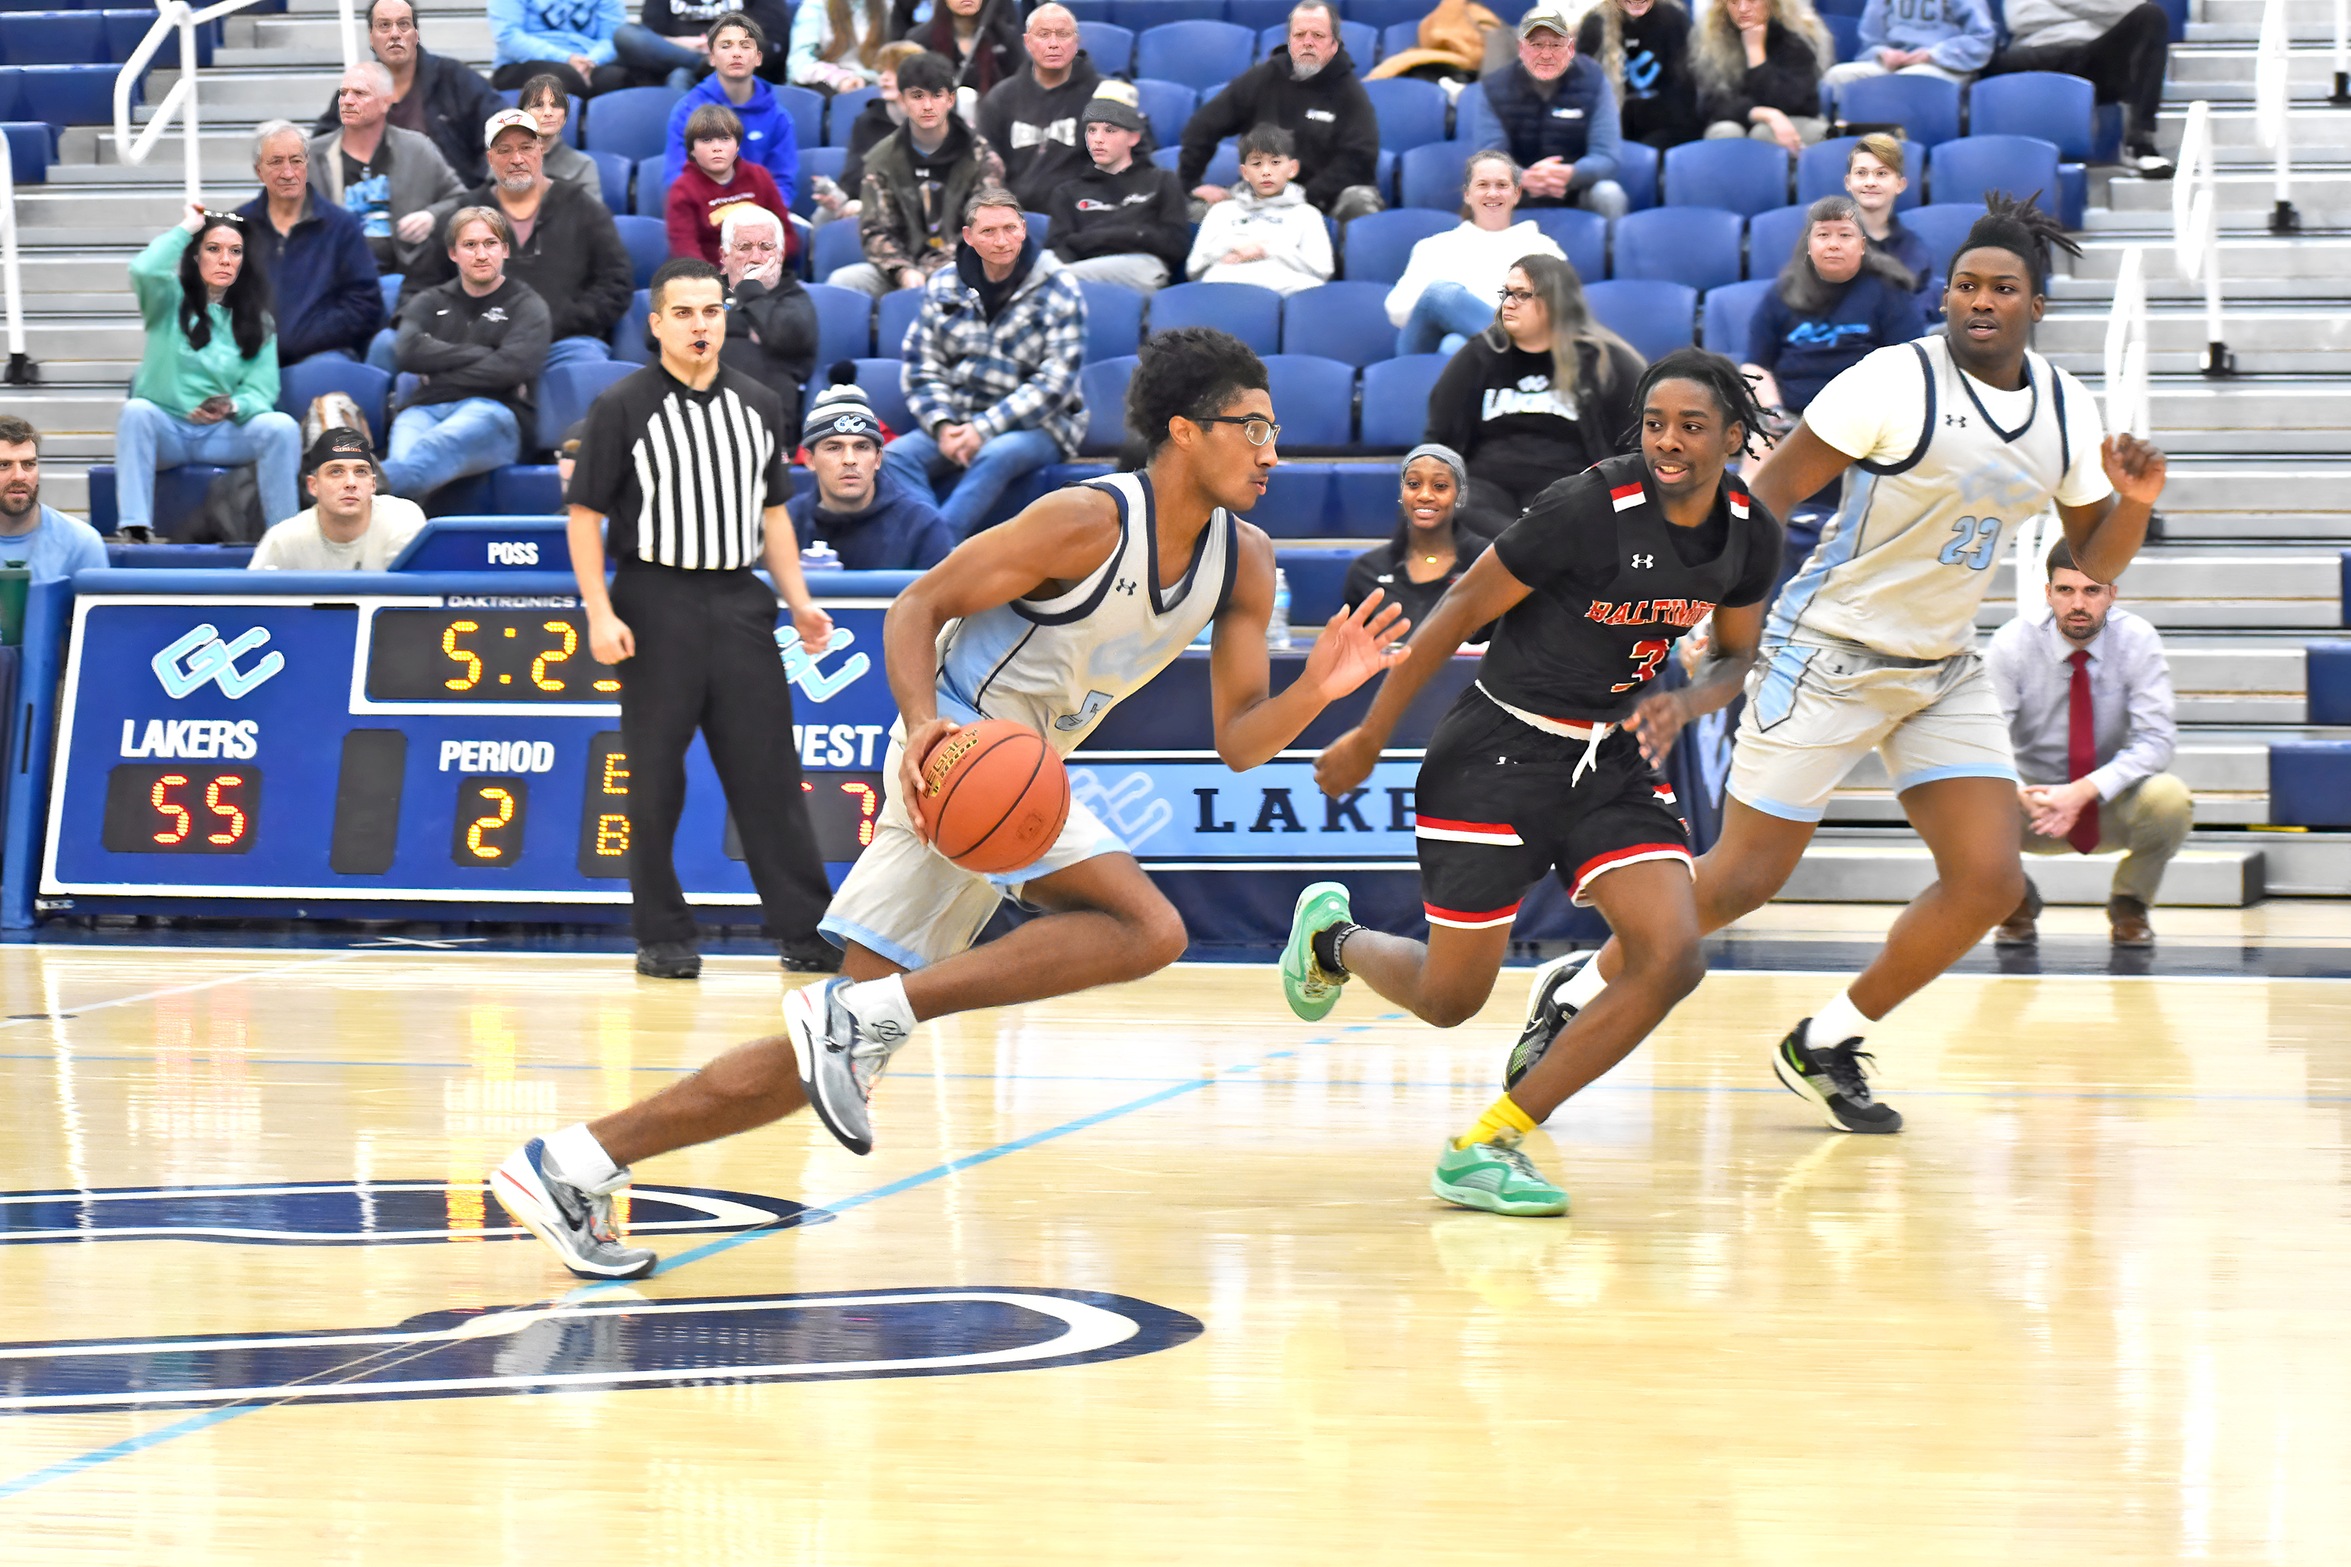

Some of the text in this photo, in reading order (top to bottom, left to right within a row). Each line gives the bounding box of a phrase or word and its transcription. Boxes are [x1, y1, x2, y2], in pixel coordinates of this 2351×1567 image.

[487, 542, 540, 565] POSS
[1938, 515, 2003, 571] 23
[447, 595, 577, 608] DAKTRONICS
[151, 623, 286, 700] GC
[442, 619, 622, 692] 5:2
[1610, 638, 1670, 693] 3
[120, 719, 259, 759] LAKERS
[439, 740, 556, 773] PERIOD
[792, 724, 883, 767] EST
[151, 774, 246, 846] 55
[466, 787, 514, 858] 2
[1193, 788, 1415, 833] LAKE
